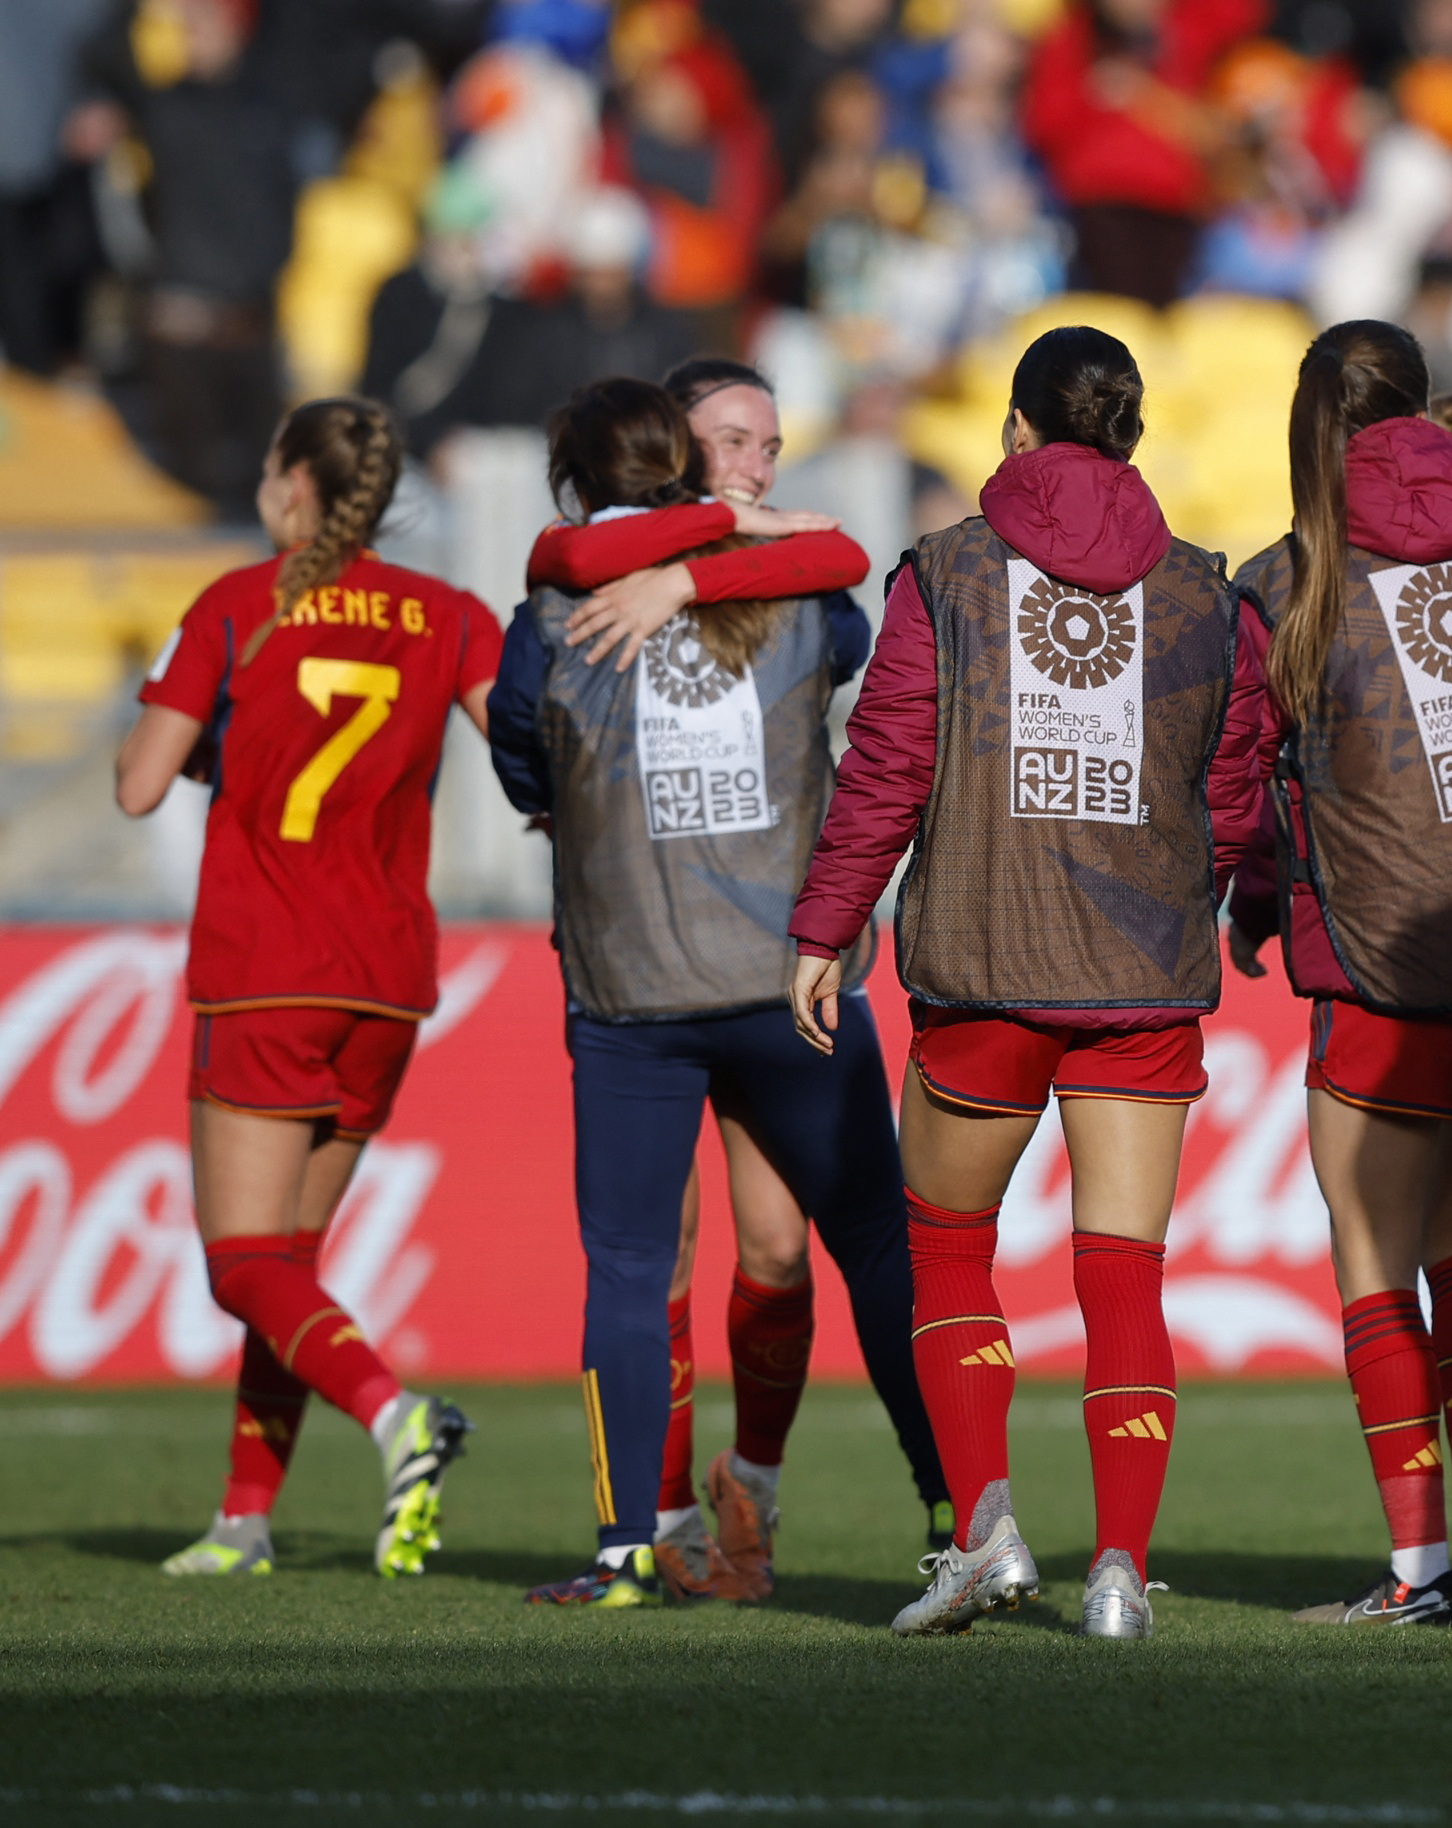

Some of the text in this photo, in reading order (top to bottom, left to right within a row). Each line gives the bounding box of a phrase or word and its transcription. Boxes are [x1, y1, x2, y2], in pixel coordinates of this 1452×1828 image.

[1018, 693, 1062, 709] FIFA
[644, 717, 679, 732] FIFA
[1019, 710, 1101, 728] WOMEN'S
[646, 730, 721, 747] WOMEN'S
[1019, 726, 1117, 745] WORLD CUP
[280, 656, 401, 843] 7
[648, 744, 739, 762] WORLD CUP
[1019, 752, 1133, 786] AU 20
[651, 769, 758, 800] AU 20
[1019, 782, 1131, 815] NZ 23
[652, 801, 703, 832] NZ
[713, 797, 761, 822] 23
